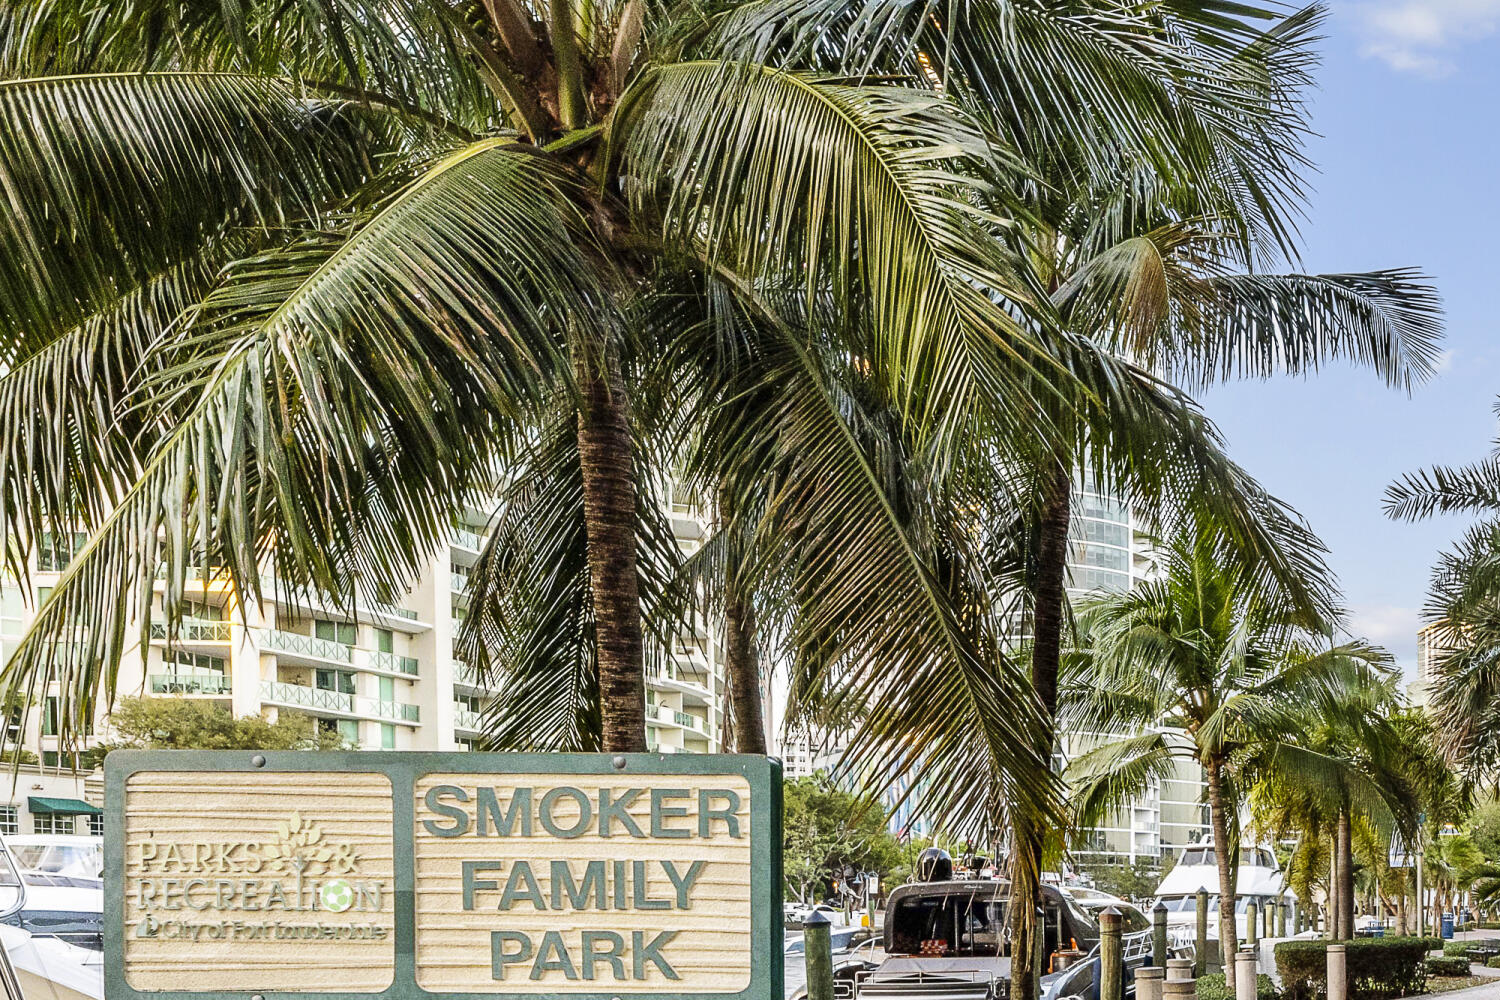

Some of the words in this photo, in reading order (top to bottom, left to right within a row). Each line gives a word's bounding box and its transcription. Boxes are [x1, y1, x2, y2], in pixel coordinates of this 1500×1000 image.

[422, 785, 742, 839] SMOKER
[138, 841, 262, 874] PARKS
[335, 843, 362, 874] &
[136, 878, 386, 914] RECREATION
[461, 859, 708, 911] FAMILY
[163, 921, 201, 943] City
[208, 921, 228, 939] of
[232, 921, 267, 939] Fort
[274, 921, 388, 939] Lauderdale
[490, 930, 683, 980] PARK
